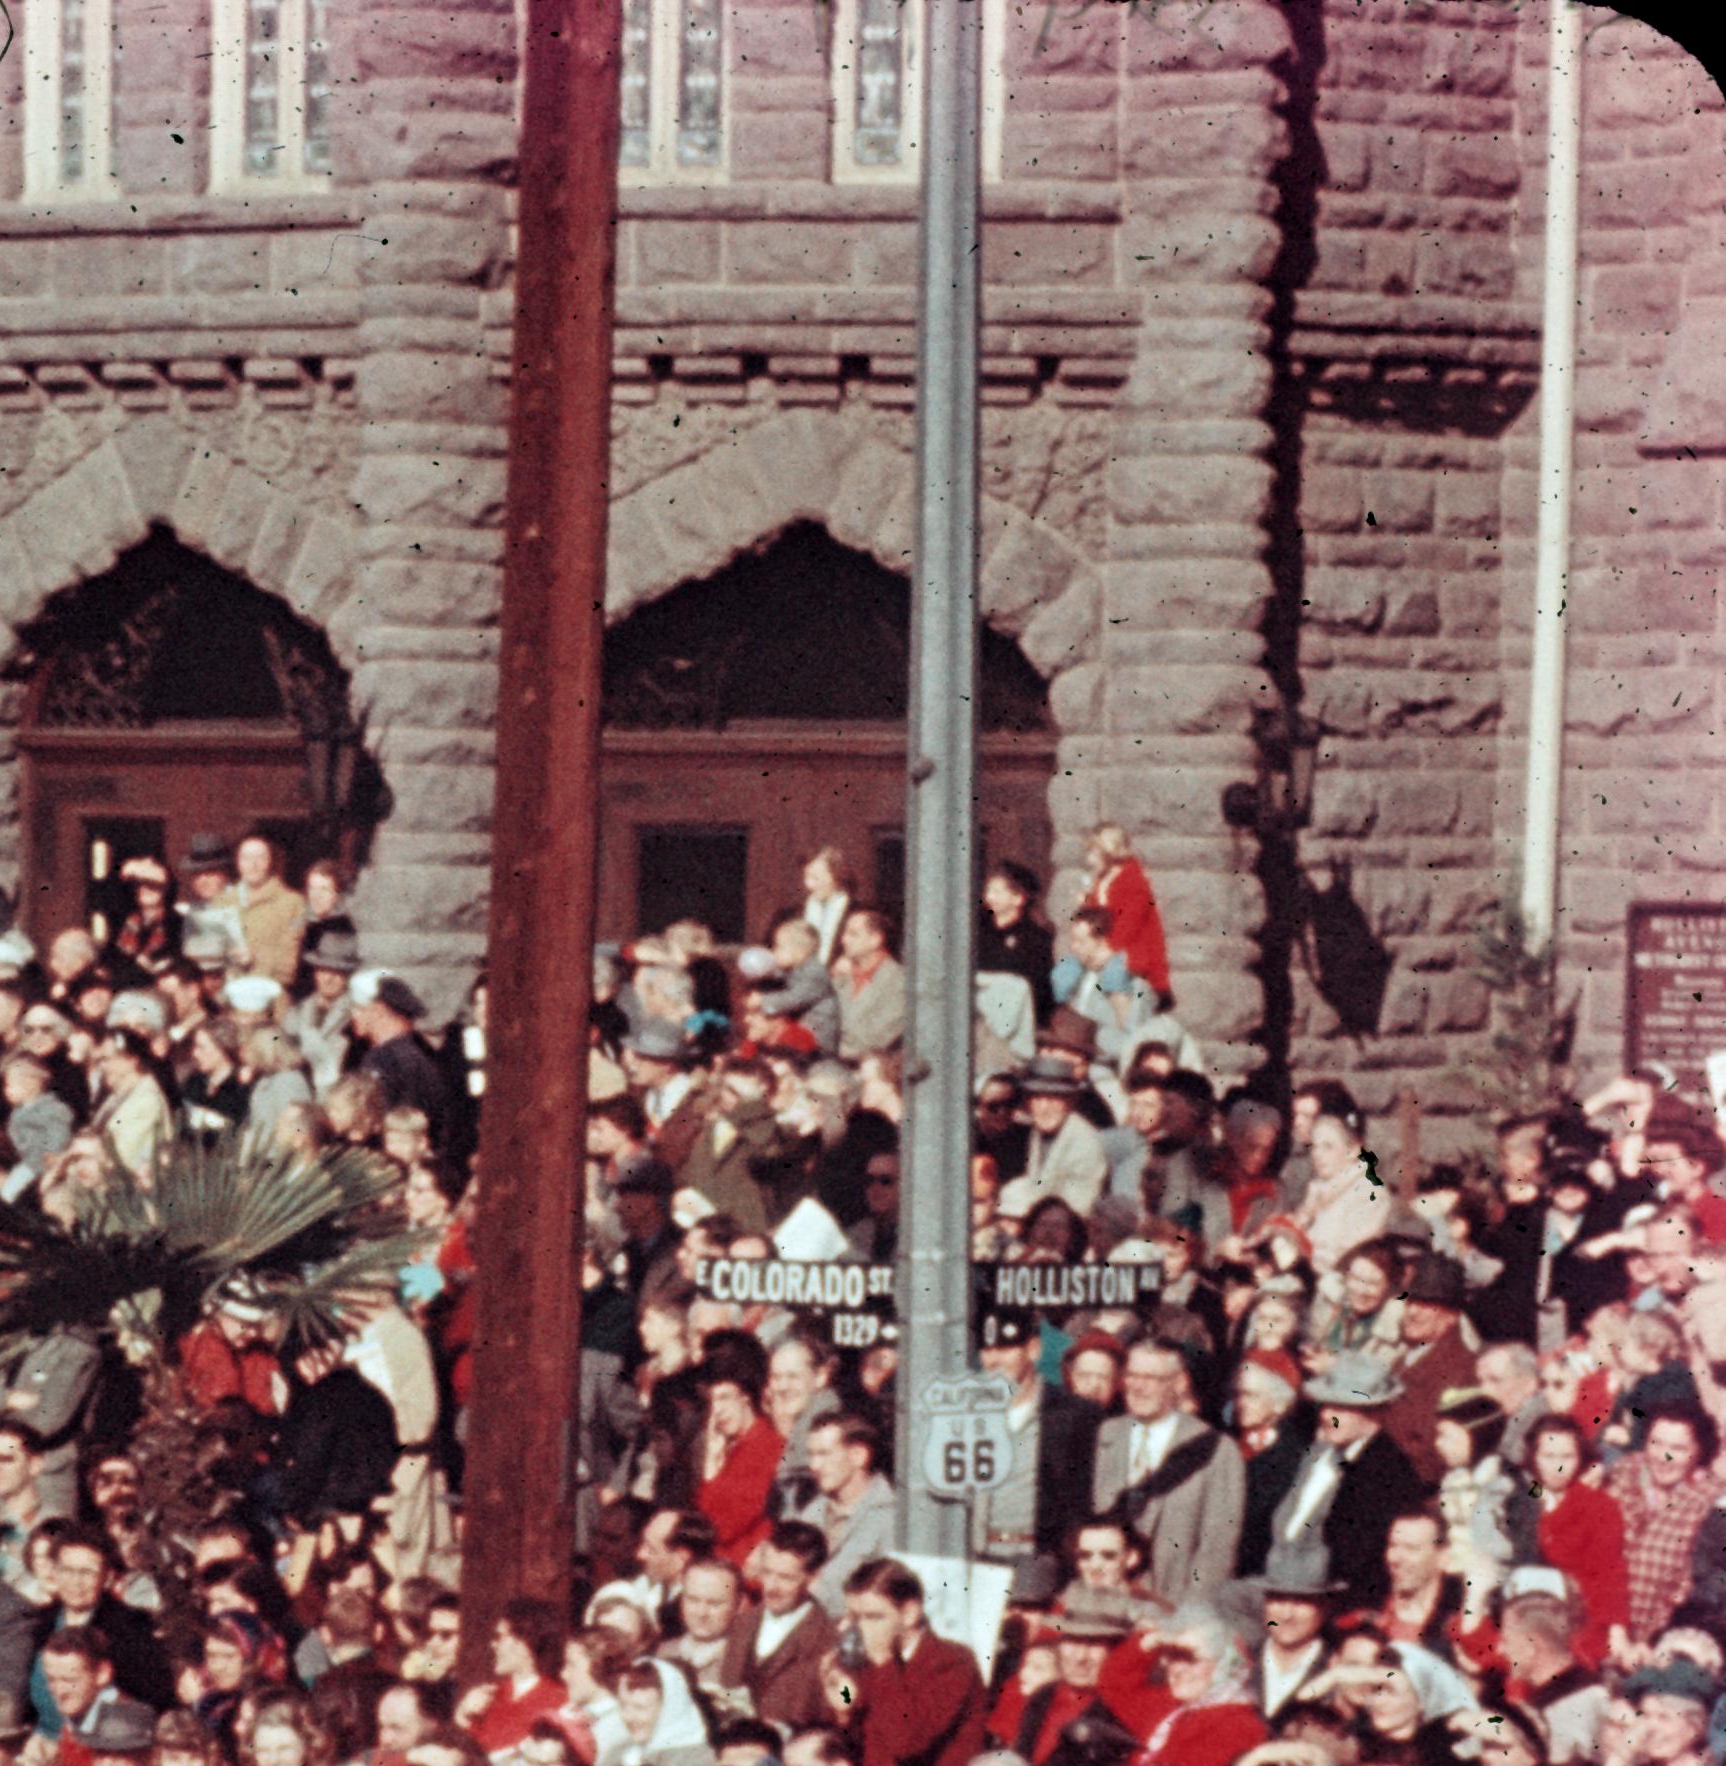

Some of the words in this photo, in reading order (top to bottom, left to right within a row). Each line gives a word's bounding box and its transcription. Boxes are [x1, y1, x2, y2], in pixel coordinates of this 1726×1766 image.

[712, 1260, 864, 1307] COLORADO
[997, 1265, 1136, 1306] HOLLISTON
[944, 1440, 995, 1483] 66
